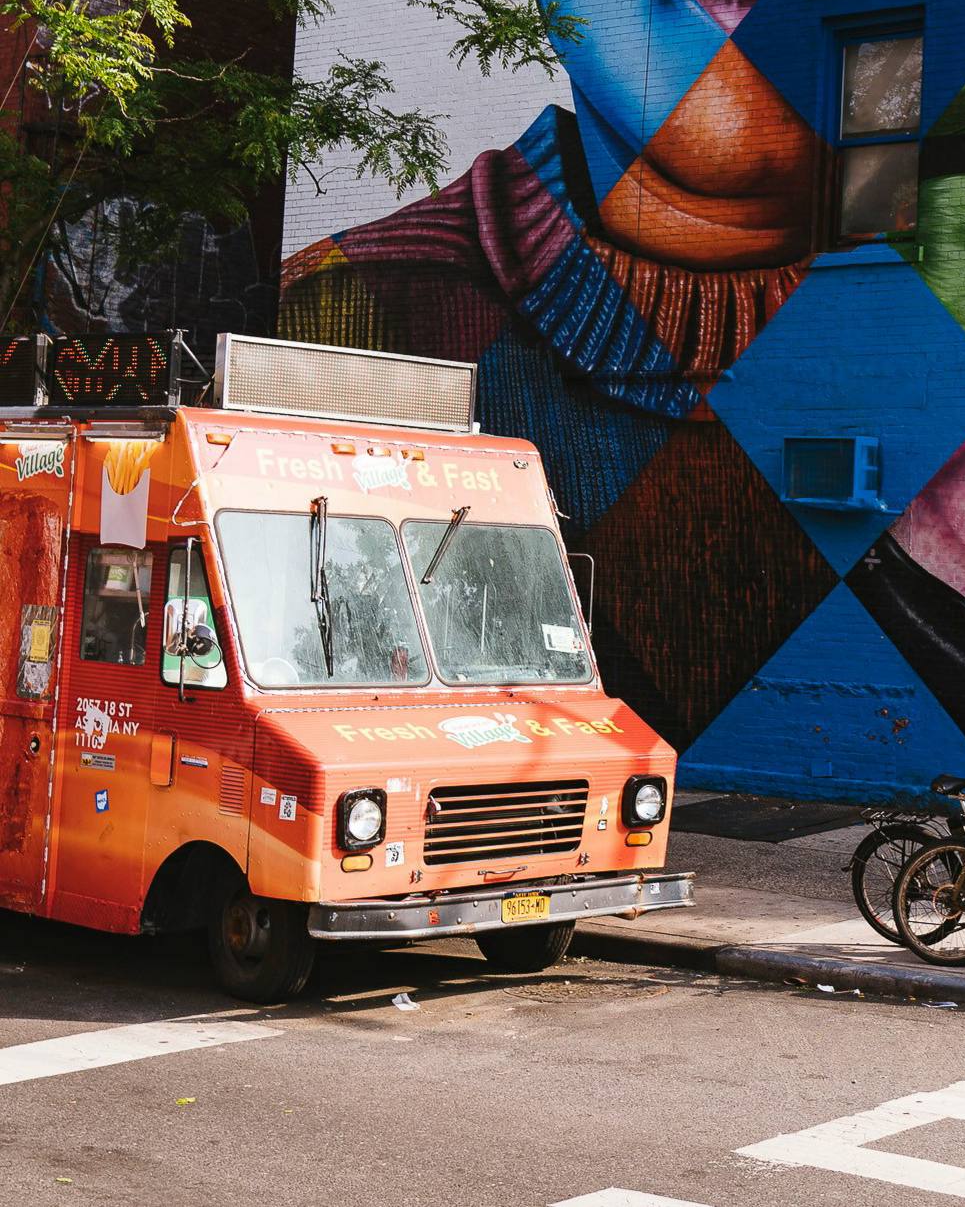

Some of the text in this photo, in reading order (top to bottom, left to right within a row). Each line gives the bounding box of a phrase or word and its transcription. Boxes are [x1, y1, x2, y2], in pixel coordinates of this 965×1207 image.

[256, 448, 344, 481] Fresh
[416, 461, 437, 486] &
[441, 462, 503, 491] Fast
[104, 700, 116, 716] 18
[118, 702, 133, 718] ST
[123, 720, 140, 736] NY
[332, 722, 437, 743] Fresh
[525, 718, 555, 737] &
[554, 716, 624, 737] Fast
